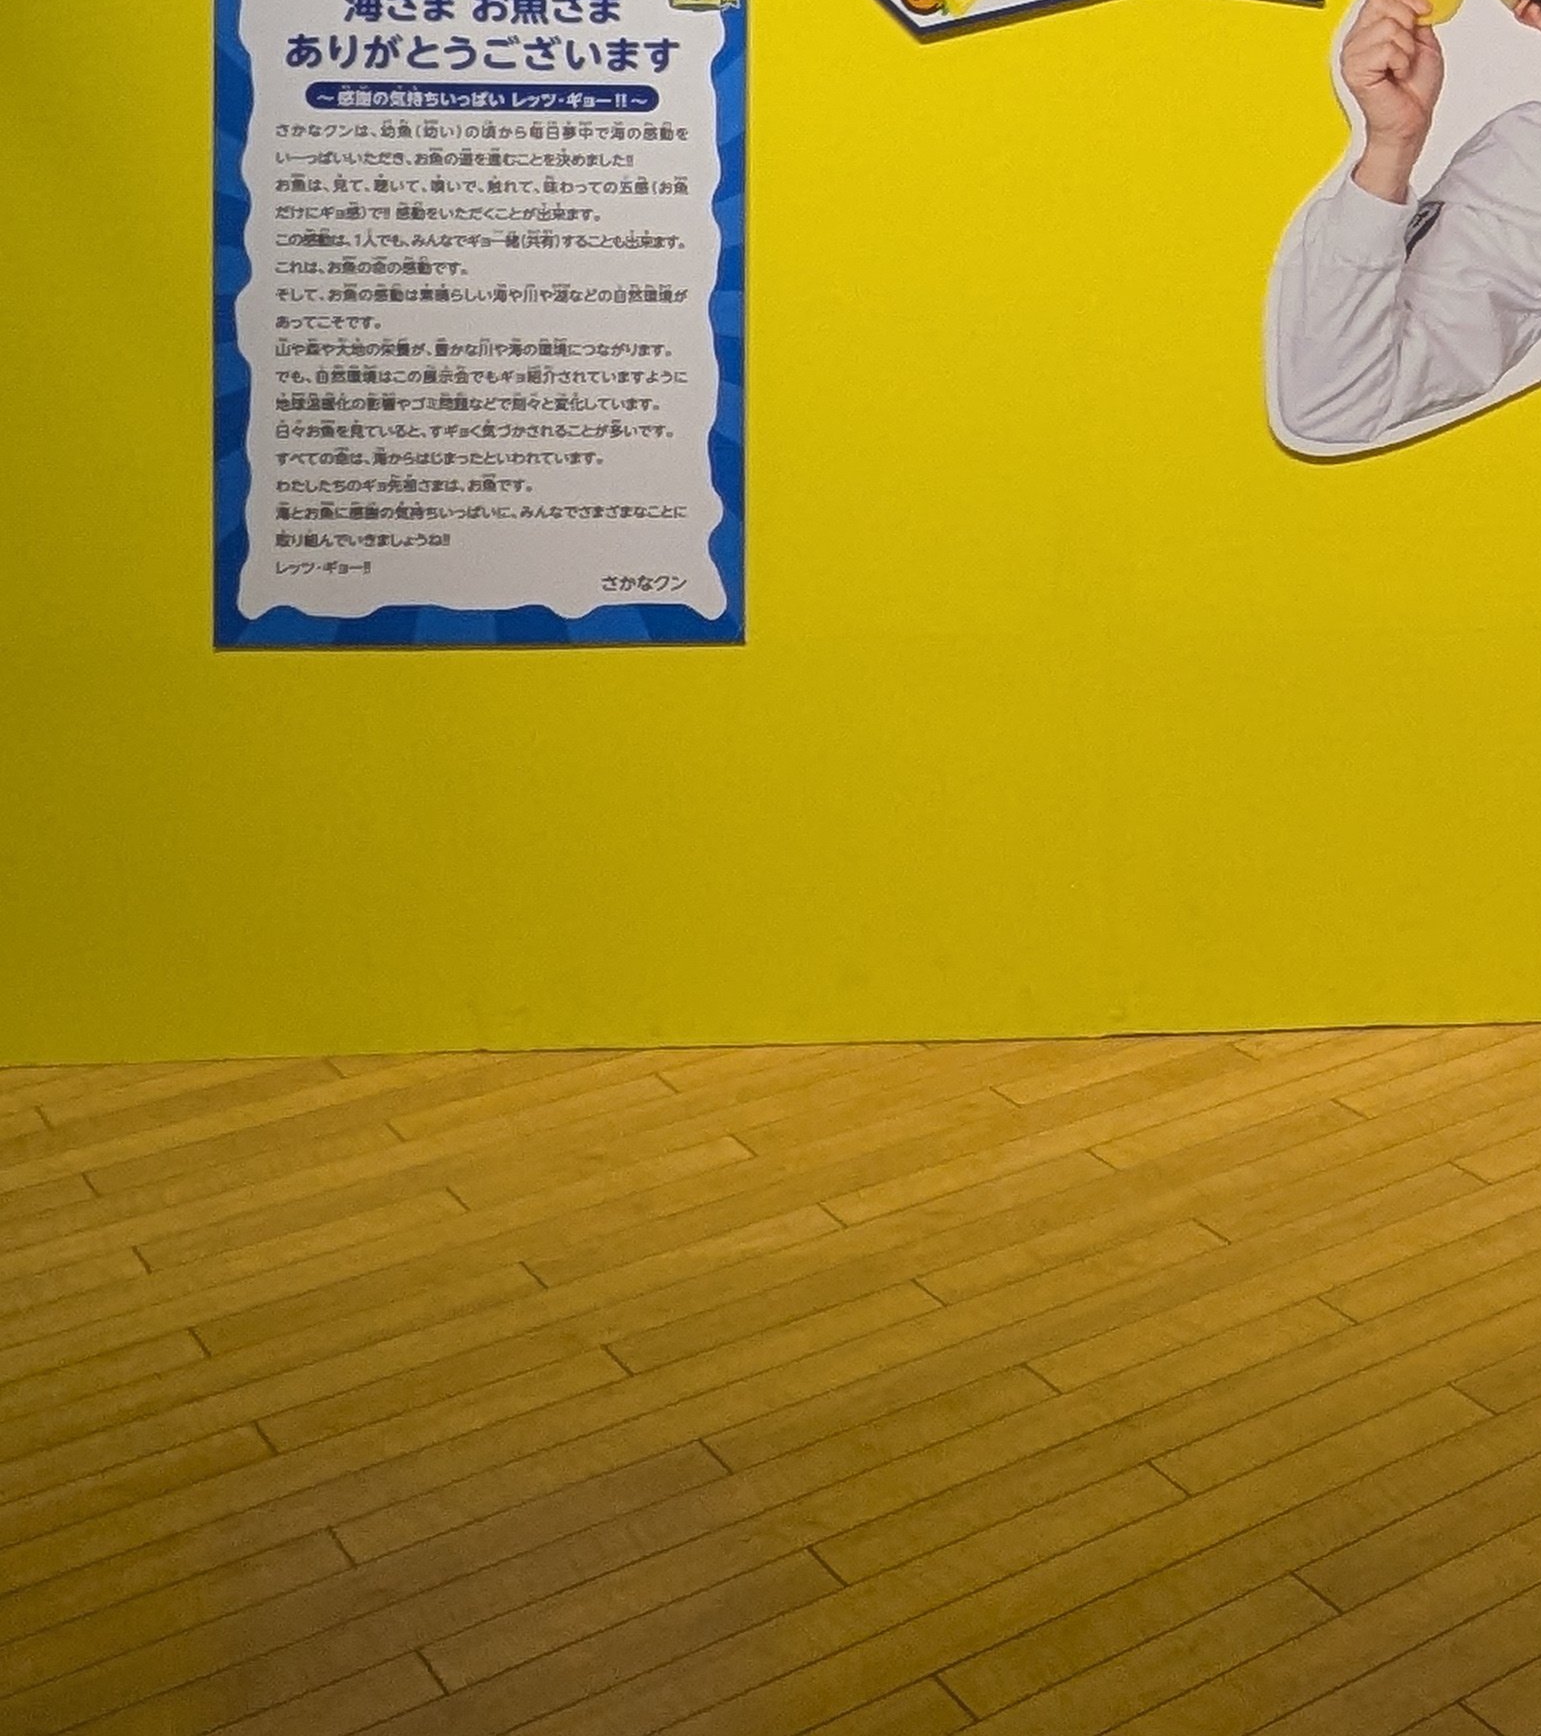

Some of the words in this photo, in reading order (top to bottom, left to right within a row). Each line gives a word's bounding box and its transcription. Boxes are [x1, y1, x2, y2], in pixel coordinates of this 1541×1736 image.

[286, 32, 680, 73] ありがとうございます
[275, 316, 382, 330] あってこそです。
[601, 574, 688, 592] さかなクン
